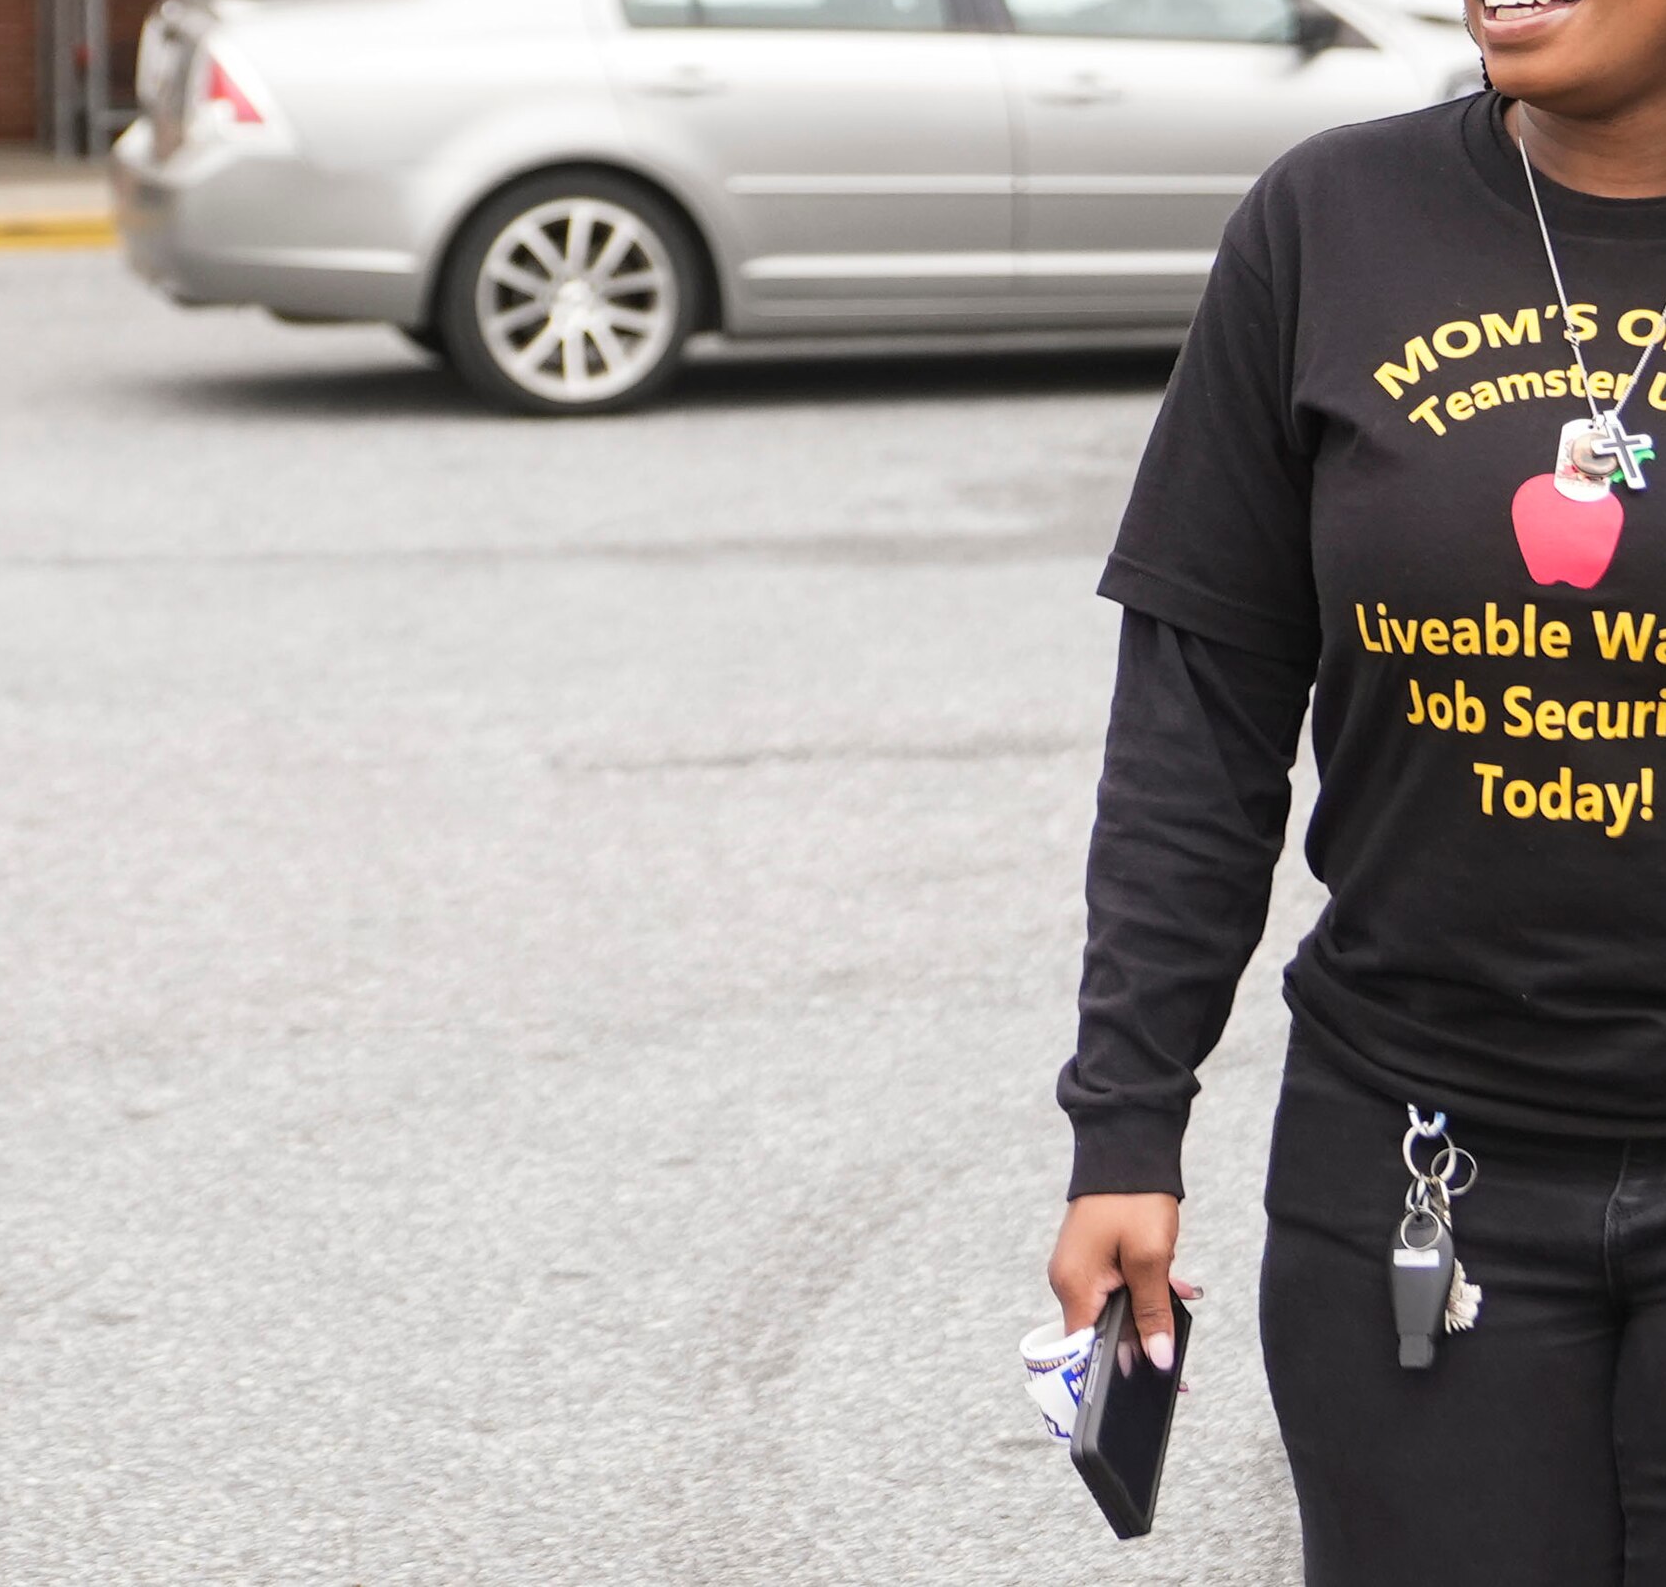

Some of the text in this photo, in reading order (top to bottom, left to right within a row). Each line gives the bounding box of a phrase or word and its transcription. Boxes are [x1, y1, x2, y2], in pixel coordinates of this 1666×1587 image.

[1408, 364, 1633, 437] Teamster
[1355, 602, 1572, 659] Liveable
[1407, 680, 1486, 734] Job
[1473, 762, 1654, 838] Today!
